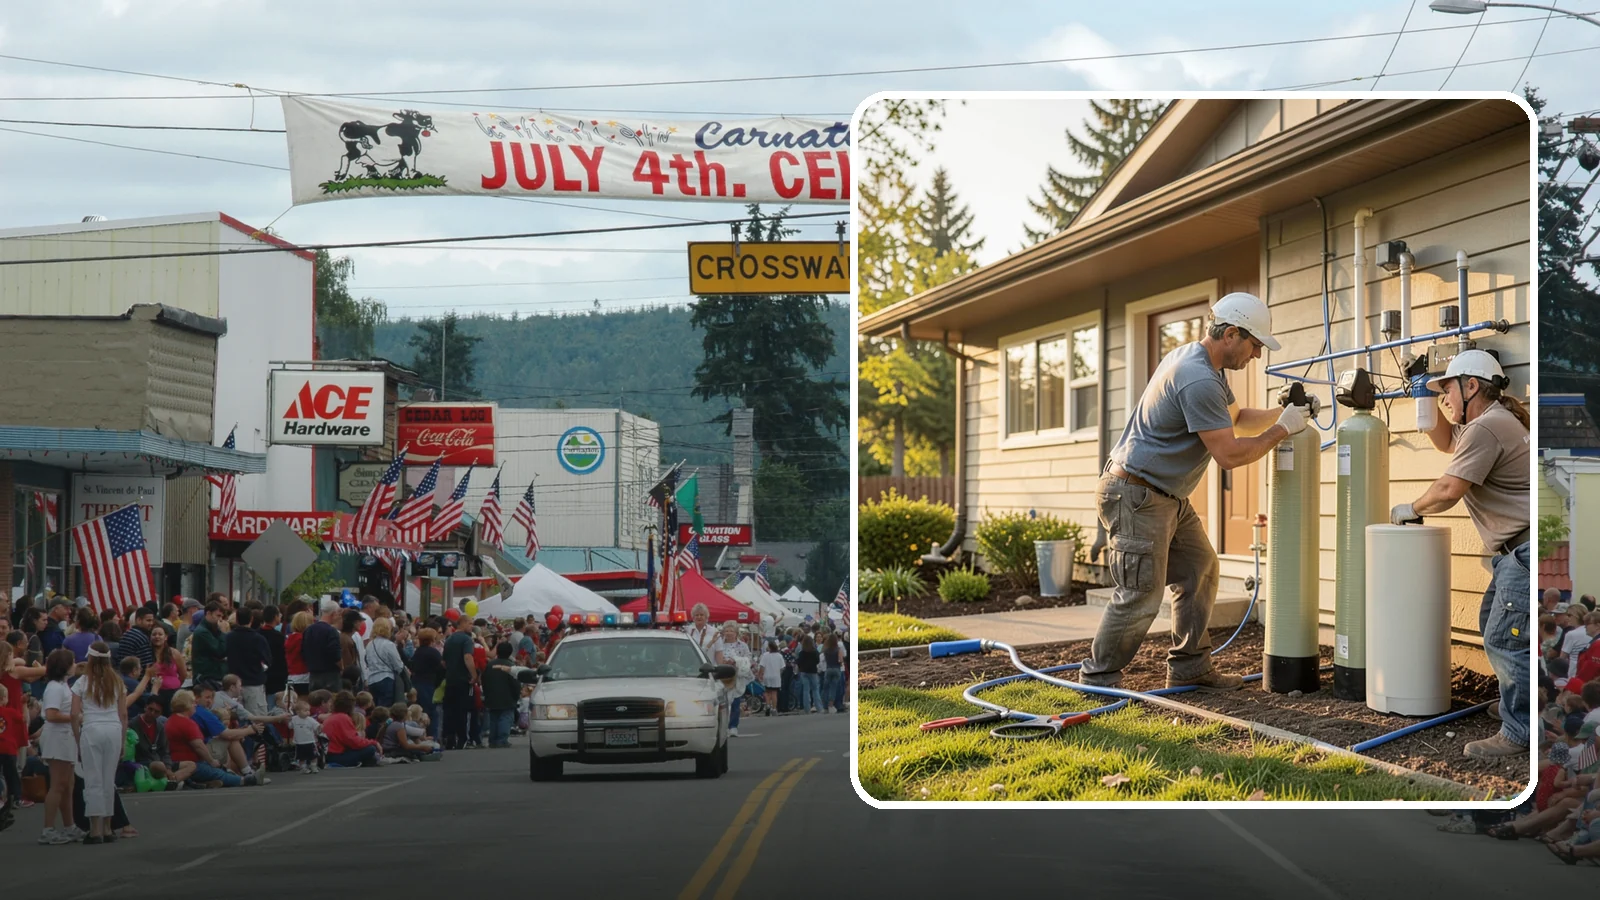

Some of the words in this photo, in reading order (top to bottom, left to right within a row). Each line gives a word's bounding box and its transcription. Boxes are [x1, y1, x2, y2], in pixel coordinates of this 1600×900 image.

[695, 120, 850, 149] Carnat
[480, 141, 605, 193] JULY
[632, 149, 747, 198] 4th.
[697, 254, 850, 281] CROSSWA
[283, 380, 373, 420] ACE
[405, 409, 453, 422] CEDAR
[460, 409, 486, 422] LOG
[283, 421, 371, 437] Hardware
[416, 428, 477, 447] Coca-Cola
[353, 466, 385, 480] Simpl
[95, 485, 124, 495] Vincent
[126, 485, 136, 495] de
[137, 486, 155, 495] Paul
[688, 526, 741, 535] CRNATION
